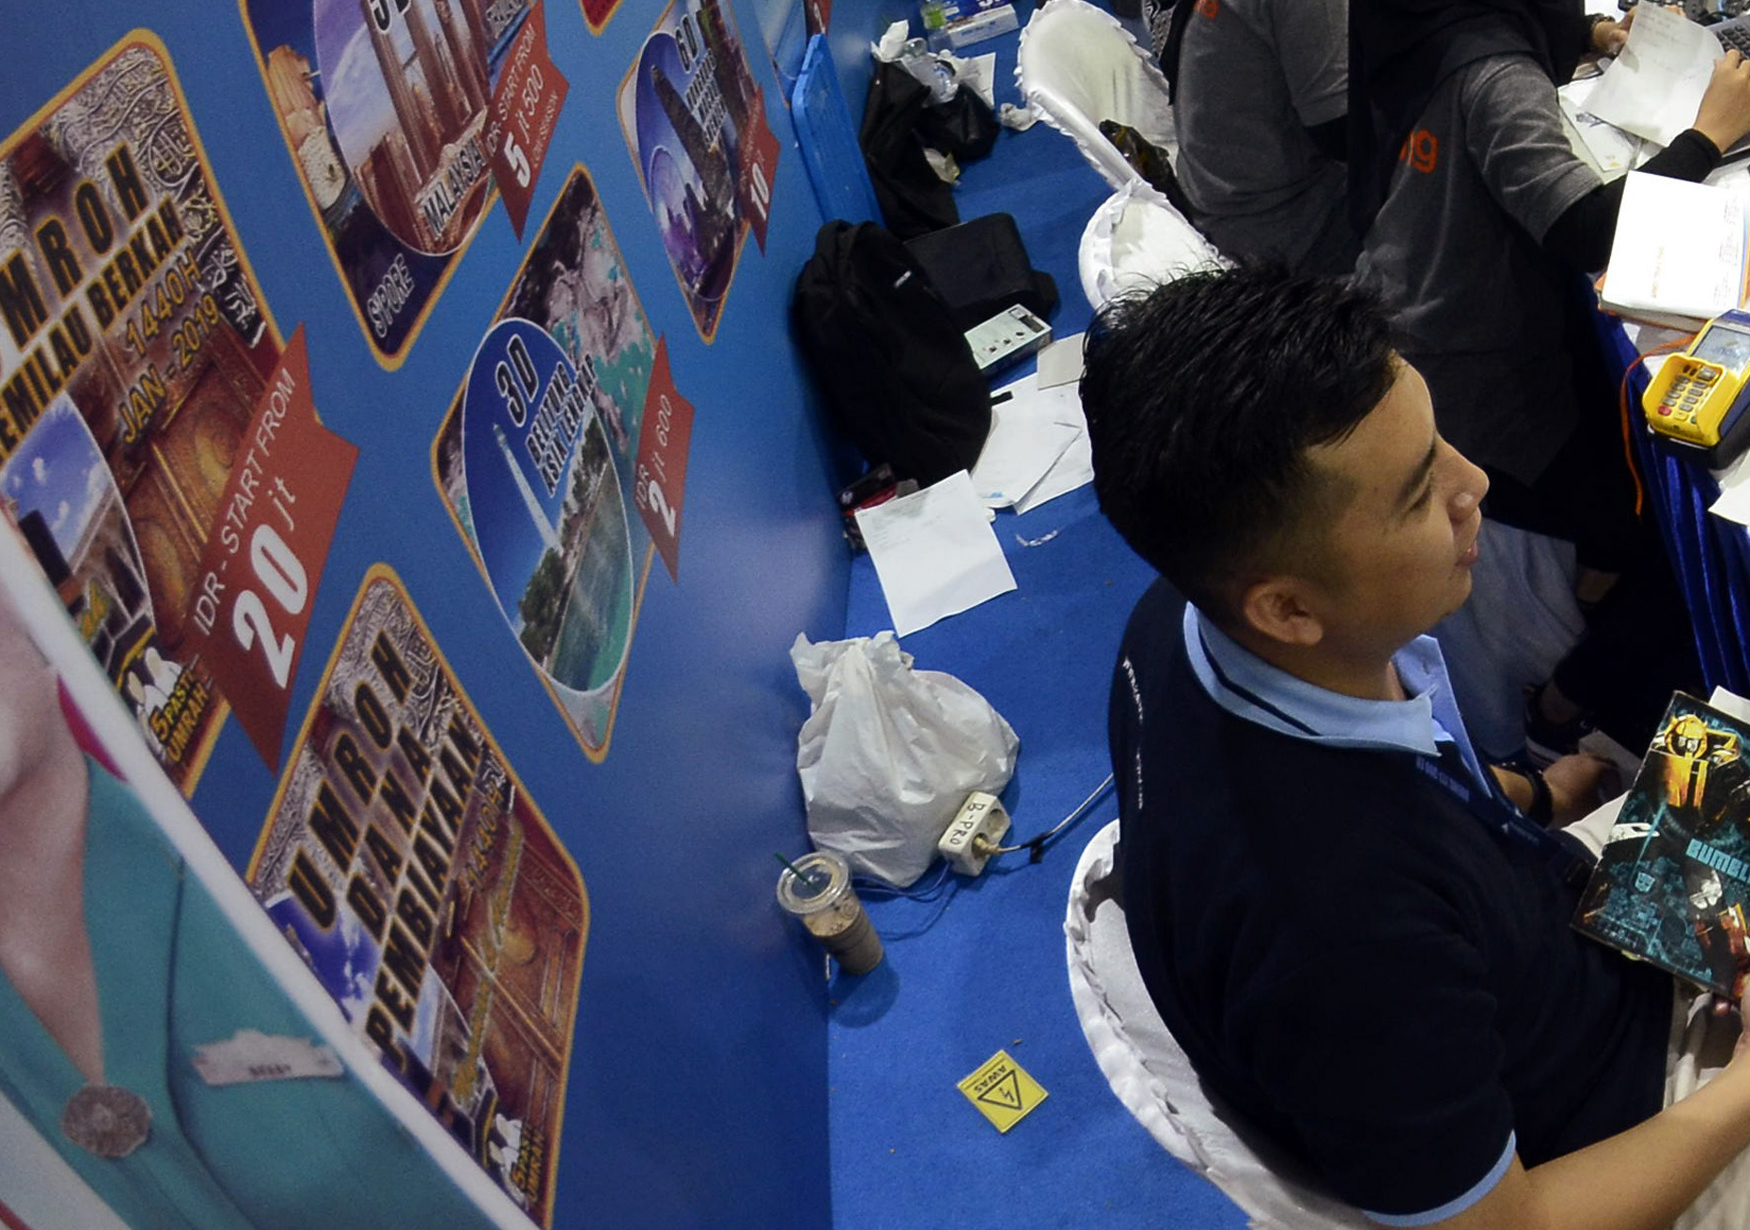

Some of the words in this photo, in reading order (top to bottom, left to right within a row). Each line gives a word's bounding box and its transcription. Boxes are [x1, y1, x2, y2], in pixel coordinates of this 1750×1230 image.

[503, 131, 531, 188] 5
[522, 64, 544, 116] 500
[750, 161, 770, 221] 10
[0, 301, 94, 462] EMILAU
[86, 194, 187, 335] BERKAH
[124, 247, 203, 358] 1440H
[118, 364, 168, 444] JAN
[171, 291, 221, 369] 2019
[495, 334, 540, 428] 3D
[655, 394, 673, 448] 600
[193, 562, 227, 636] IDR
[219, 453, 262, 553] START
[253, 367, 297, 460] FROM
[635, 463, 650, 510] IDR
[648, 479, 677, 538] 2
[231, 521, 309, 690] 20
[273, 475, 298, 532] jt
[286, 628, 415, 932] UMROH
[345, 723, 432, 945] DANA
[949, 802, 986, 846] B-PRO
[973, 1064, 1007, 1093] AWAS
